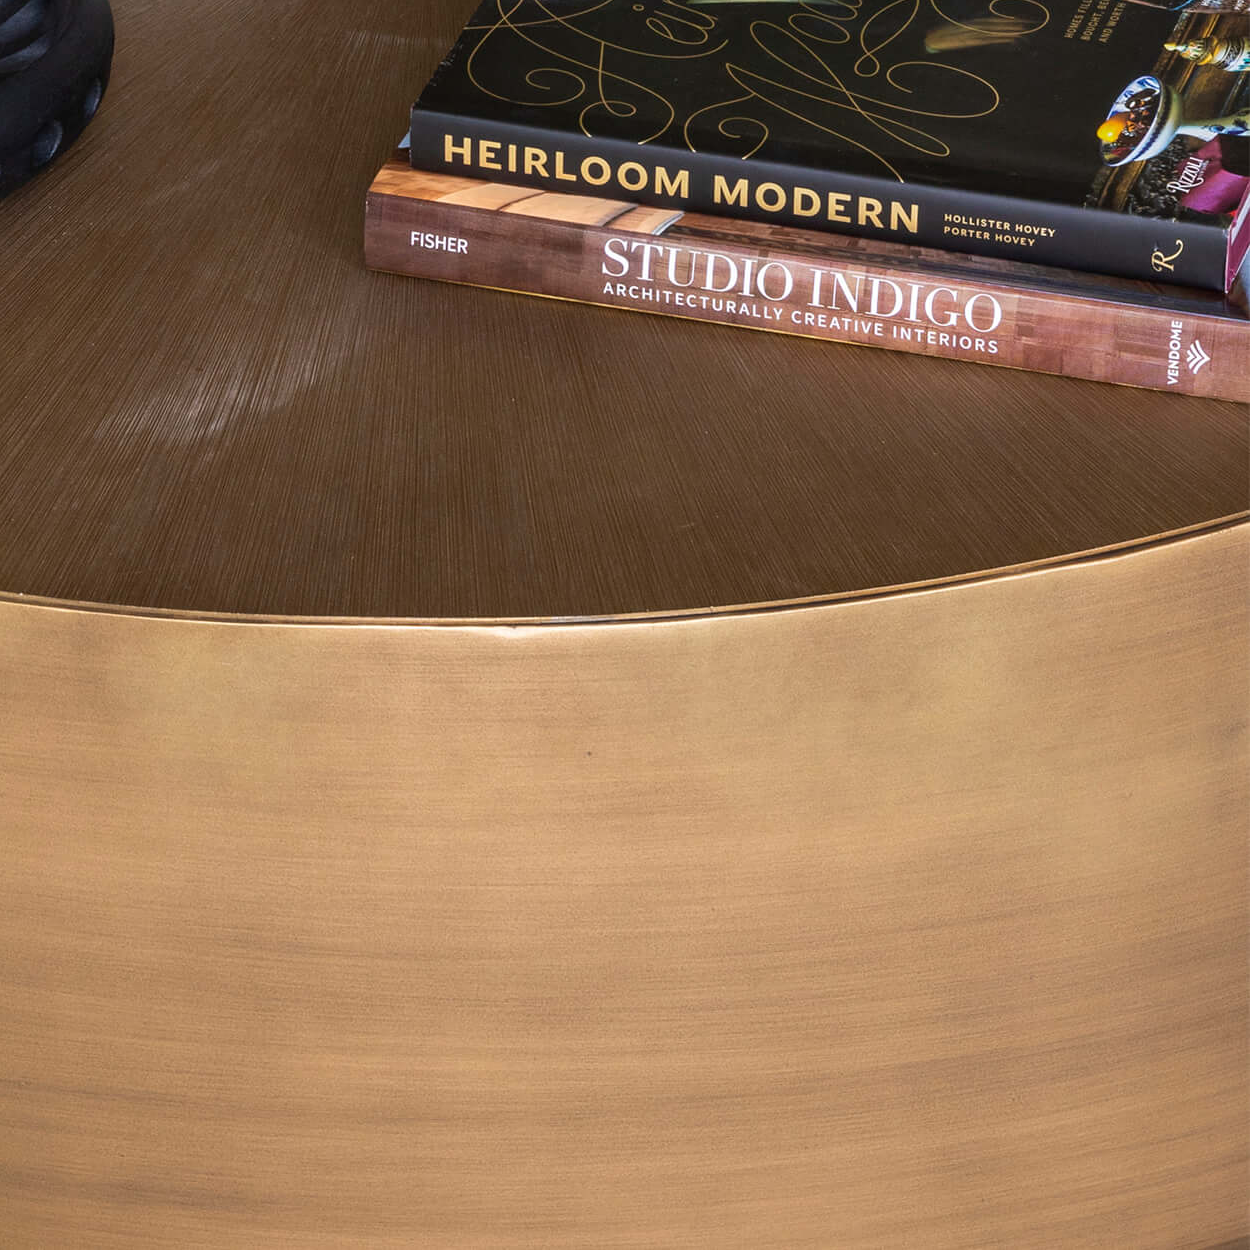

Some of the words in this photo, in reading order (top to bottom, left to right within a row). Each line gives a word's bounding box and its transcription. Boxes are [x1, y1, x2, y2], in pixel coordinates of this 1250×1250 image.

[1064, 14, 1084, 39] HOMES
[444, 133, 690, 200] HEIRLOOM
[713, 174, 919, 234] MODERN
[410, 231, 469, 255] FISHER
[943, 213, 1011, 231] HOLLISTER
[1015, 223, 1056, 238] HOVEY
[943, 225, 991, 240] PORTER
[995, 233, 1036, 247] HOVEY
[601, 237, 795, 302] STUDIO
[807, 268, 1003, 333] INDIGO
[603, 281, 784, 321] ARCHITECTURALLY
[791, 309, 884, 338] CREATIVE
[892, 325, 999, 355] INTERIORS
[1166, 320, 1183, 386] VENDOME
